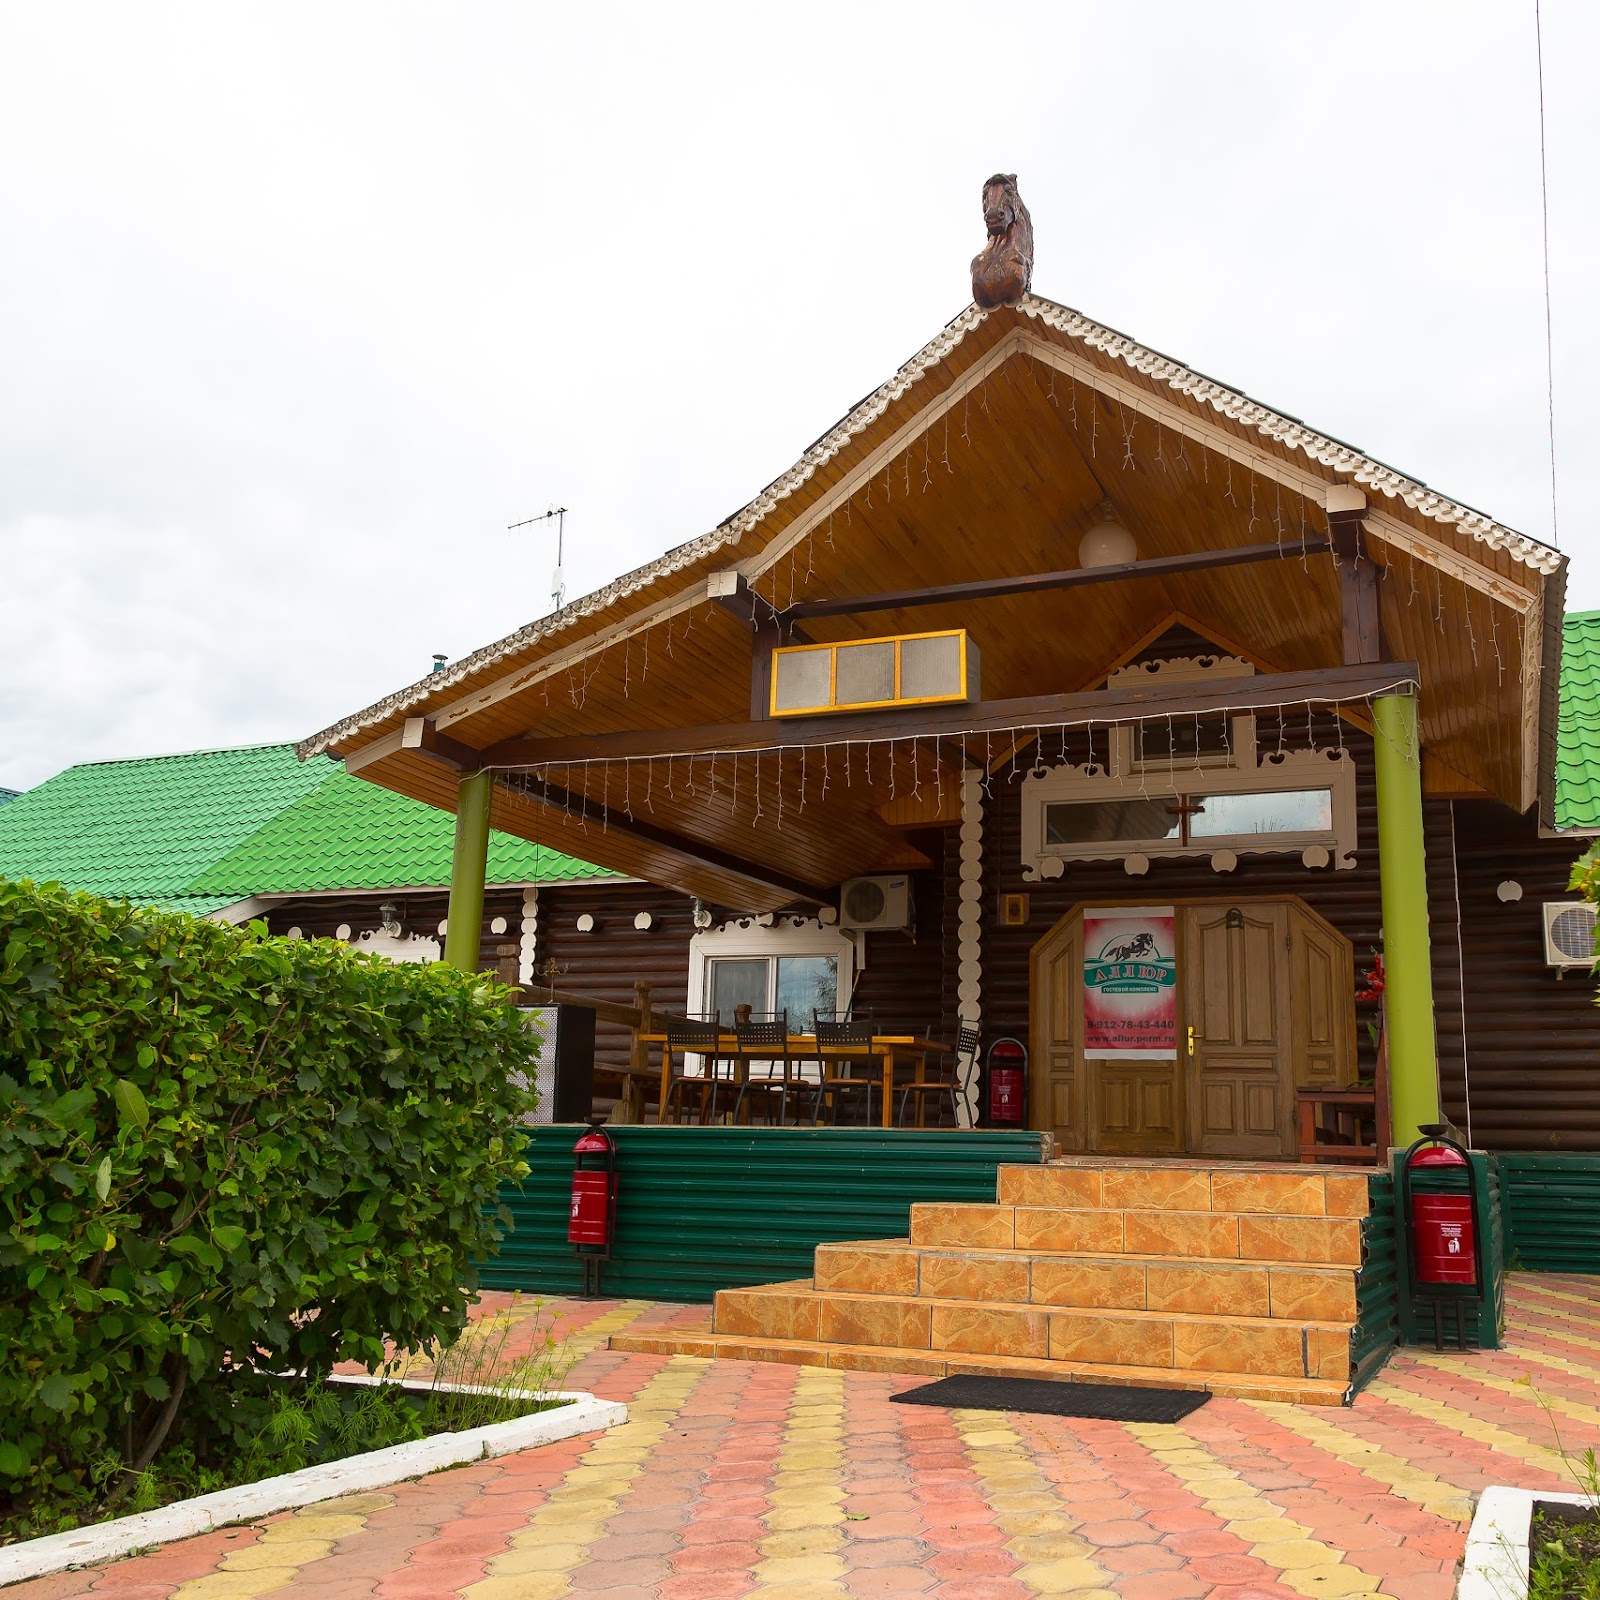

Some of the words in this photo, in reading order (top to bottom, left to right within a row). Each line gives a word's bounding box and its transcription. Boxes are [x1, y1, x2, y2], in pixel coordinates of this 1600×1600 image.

[1094, 964, 1168, 982] АЛЛЮР
[1087, 1020, 1174, 1029] 8-912-78-43-440
[1087, 1034, 1175, 1043] www.allur.perm.ru
